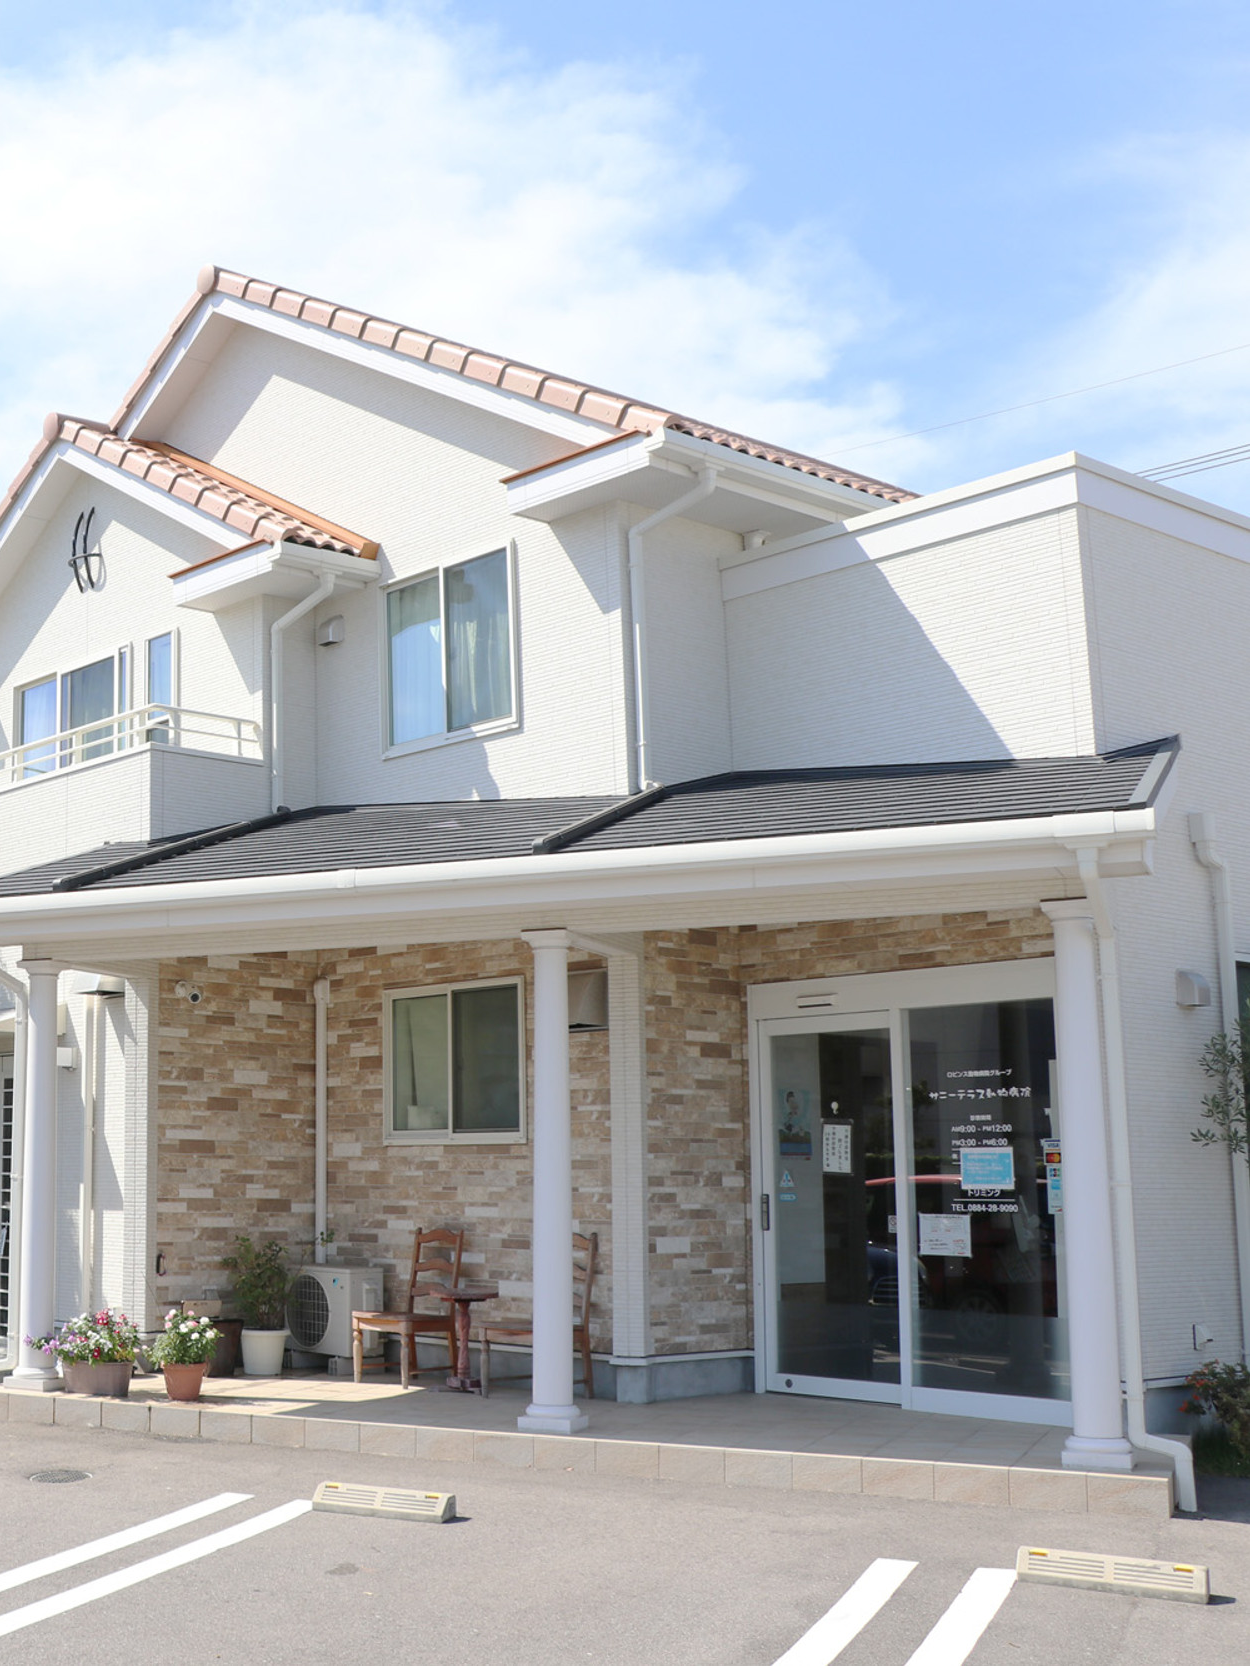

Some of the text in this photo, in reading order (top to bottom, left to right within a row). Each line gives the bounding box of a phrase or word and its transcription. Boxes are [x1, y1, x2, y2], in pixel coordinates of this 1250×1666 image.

[967, 1189, 1001, 1197] トリミング
